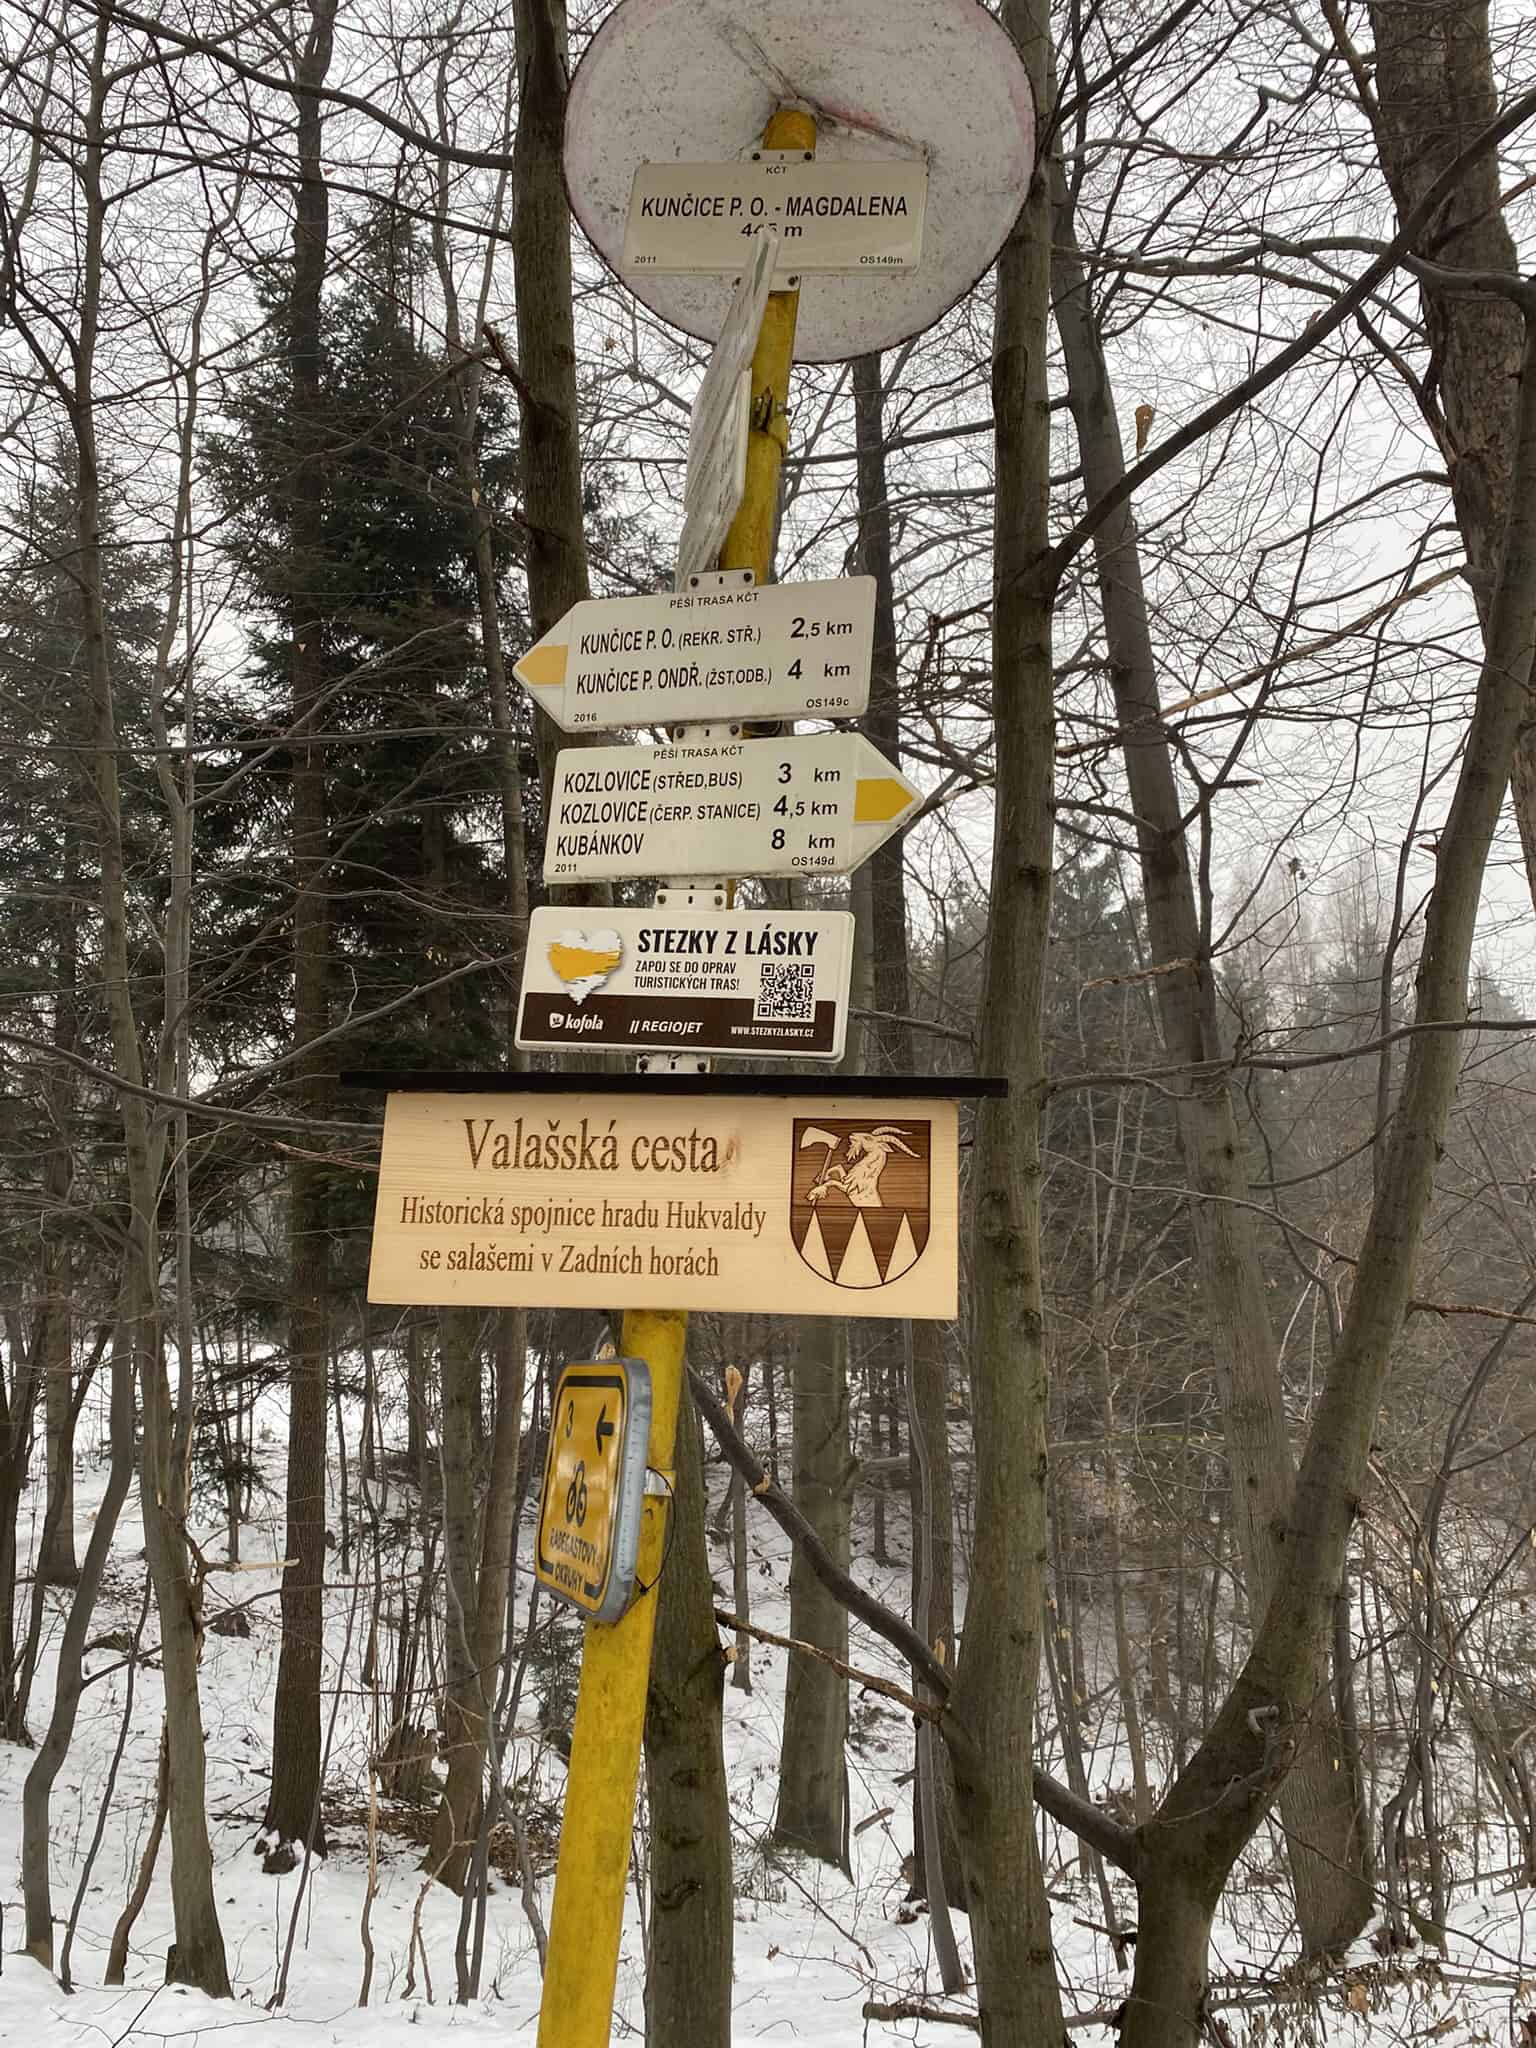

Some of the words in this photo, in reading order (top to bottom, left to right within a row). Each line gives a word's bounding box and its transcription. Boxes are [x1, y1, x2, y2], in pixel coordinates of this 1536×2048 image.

[766, 165, 787, 174] KČT
[641, 193, 723, 217] KUNČICE
[729, 198, 743, 217] P.
[750, 197, 768, 217] O.
[786, 196, 908, 217] MAGDALENA
[785, 225, 802, 237] m
[634, 256, 657, 264] 2011
[860, 256, 903, 265] OS149m
[697, 594, 734, 607] TRASA
[736, 591, 759, 603] KČT
[580, 626, 642, 655] KUNČICE
[646, 630, 656, 649] P.
[661, 628, 675, 649] O.
[678, 628, 723, 650] (REKR.
[727, 625, 761, 646] STŘ.)
[790, 617, 821, 639] 2,5
[826, 620, 852, 636] km
[577, 666, 638, 695] KUNČICE
[642, 671, 653, 690] P.
[658, 662, 703, 688] ONDŘ.
[787, 658, 803, 680] 4
[823, 662, 850, 677] km
[574, 712, 597, 722] 2016
[681, 747, 718, 759] TRASA
[720, 745, 743, 757] KČT
[563, 769, 650, 793] KOZLOVICE
[778, 762, 792, 784] 3
[813, 767, 840, 782] km
[560, 801, 648, 825] KOZLOVICE
[650, 803, 694, 825] (ČERP.
[697, 803, 761, 821] STANICE)
[772, 795, 805, 819] 4,5
[810, 800, 838, 816] km
[556, 829, 643, 857] KUBÁNKOV
[771, 828, 785, 850] 8
[808, 834, 835, 849] km
[554, 863, 577, 873] 2011
[791, 856, 835, 867] OS149d
[638, 929, 717, 954] STEZKY
[724, 931, 737, 954] Z
[745, 923, 818, 956] LÁSKY
[635, 960, 667, 974] ZAPOJ
[669, 961, 683, 974] SE
[684, 962, 699, 974] DO
[702, 962, 736, 974] OPRAV
[634, 974, 707, 990] TURISTICKÝCH
[710, 978, 740, 991] TRAS!
[564, 1012, 604, 1033] kofola
[641, 1020, 704, 1035] REGIOJET
[463, 1118, 619, 1172] Valašská
[631, 1125, 720, 1173] cesta
[400, 1196, 505, 1227] Historická
[511, 1199, 596, 1235] spojnice
[600, 1198, 660, 1229] hradu
[666, 1201, 767, 1238] Hukvaldy
[419, 1249, 442, 1270] se
[446, 1243, 534, 1273] salašemi
[540, 1253, 553, 1273] v
[558, 1243, 643, 1276] Zadních
[649, 1244, 720, 1277] horách
[566, 1400, 574, 1438] 3
